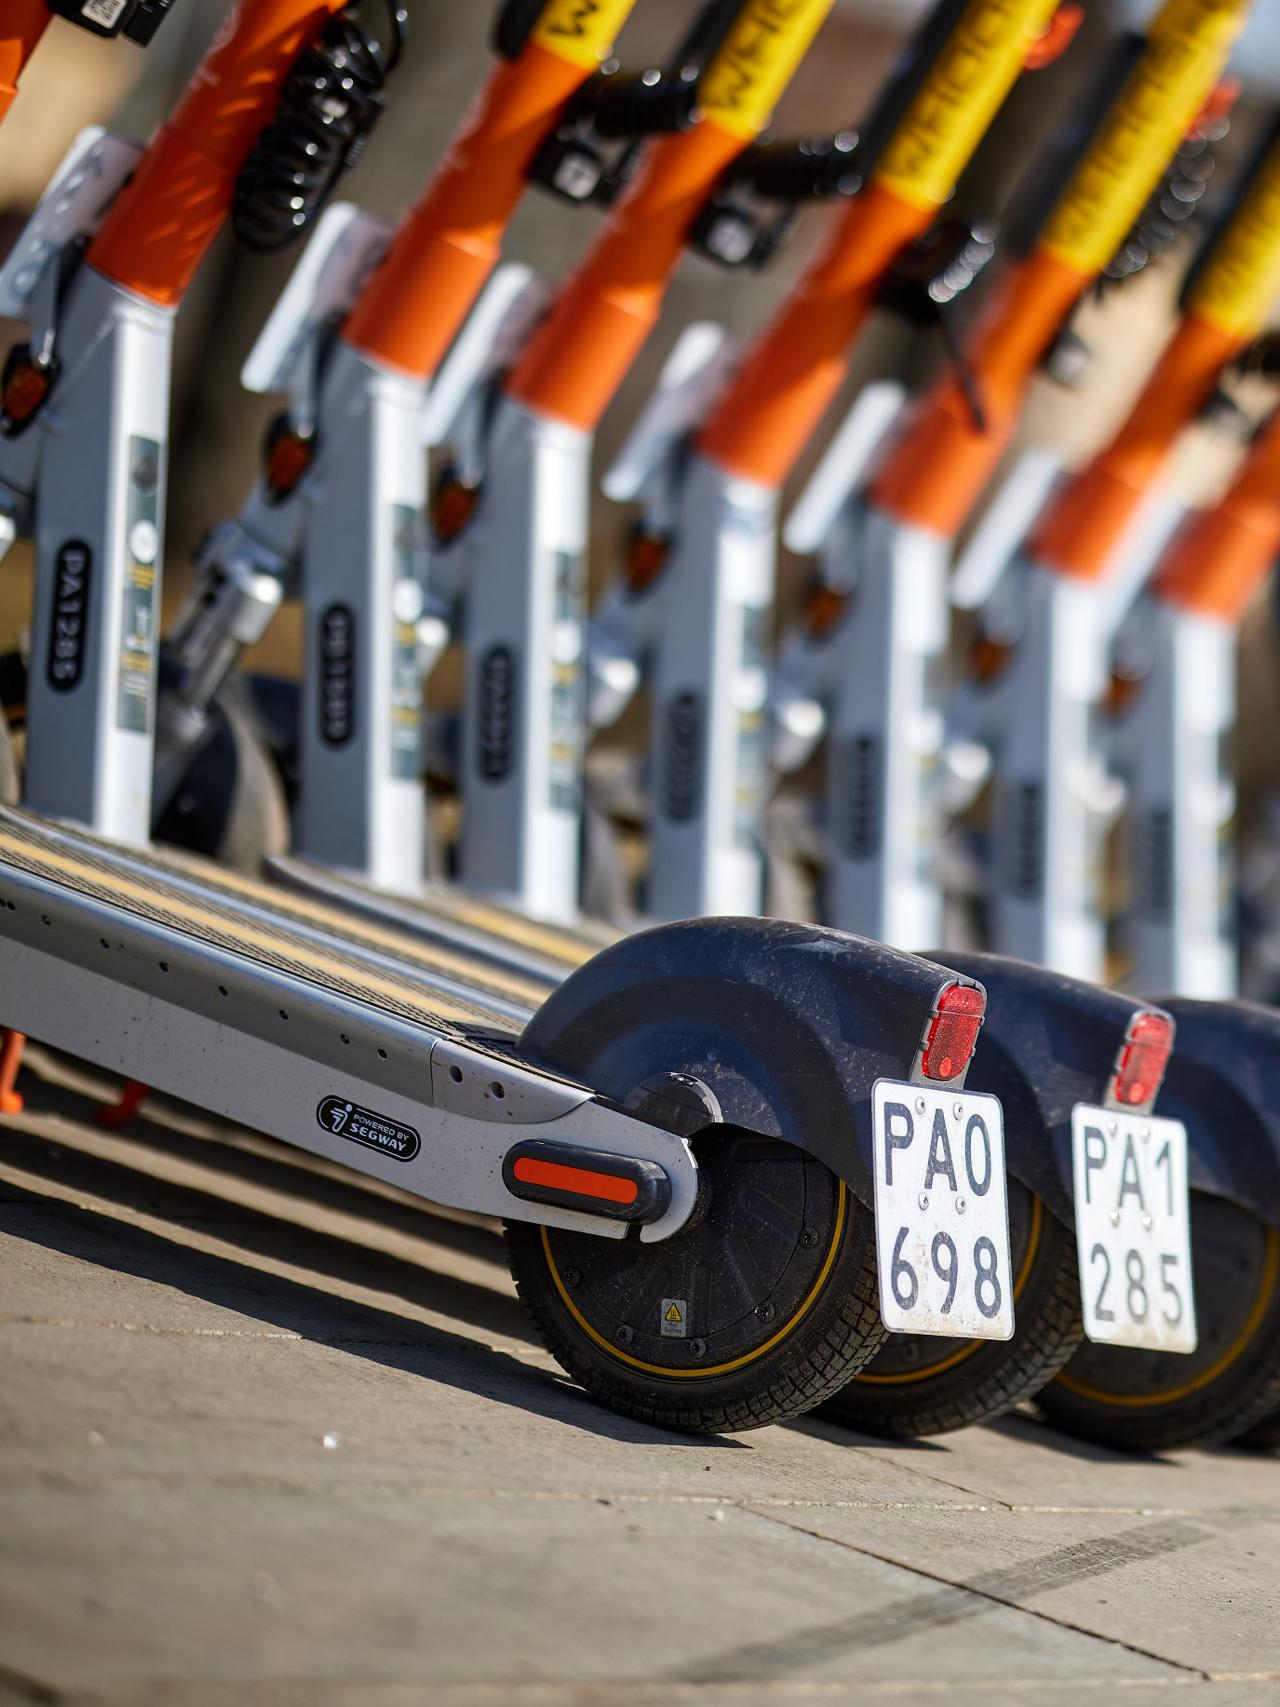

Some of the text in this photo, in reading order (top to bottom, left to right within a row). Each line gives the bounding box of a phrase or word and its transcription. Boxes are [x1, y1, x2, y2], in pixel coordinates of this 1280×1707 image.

[53, 550, 85, 680] PA1285
[349, 1122, 407, 1151] SEGWAY
[353, 1113, 410, 1141] POWERED BY
[884, 1101, 991, 1197] PA0
[1084, 1125, 1174, 1217] PA1
[891, 1226, 1002, 1319] 698
[1090, 1242, 1183, 1329] 285
